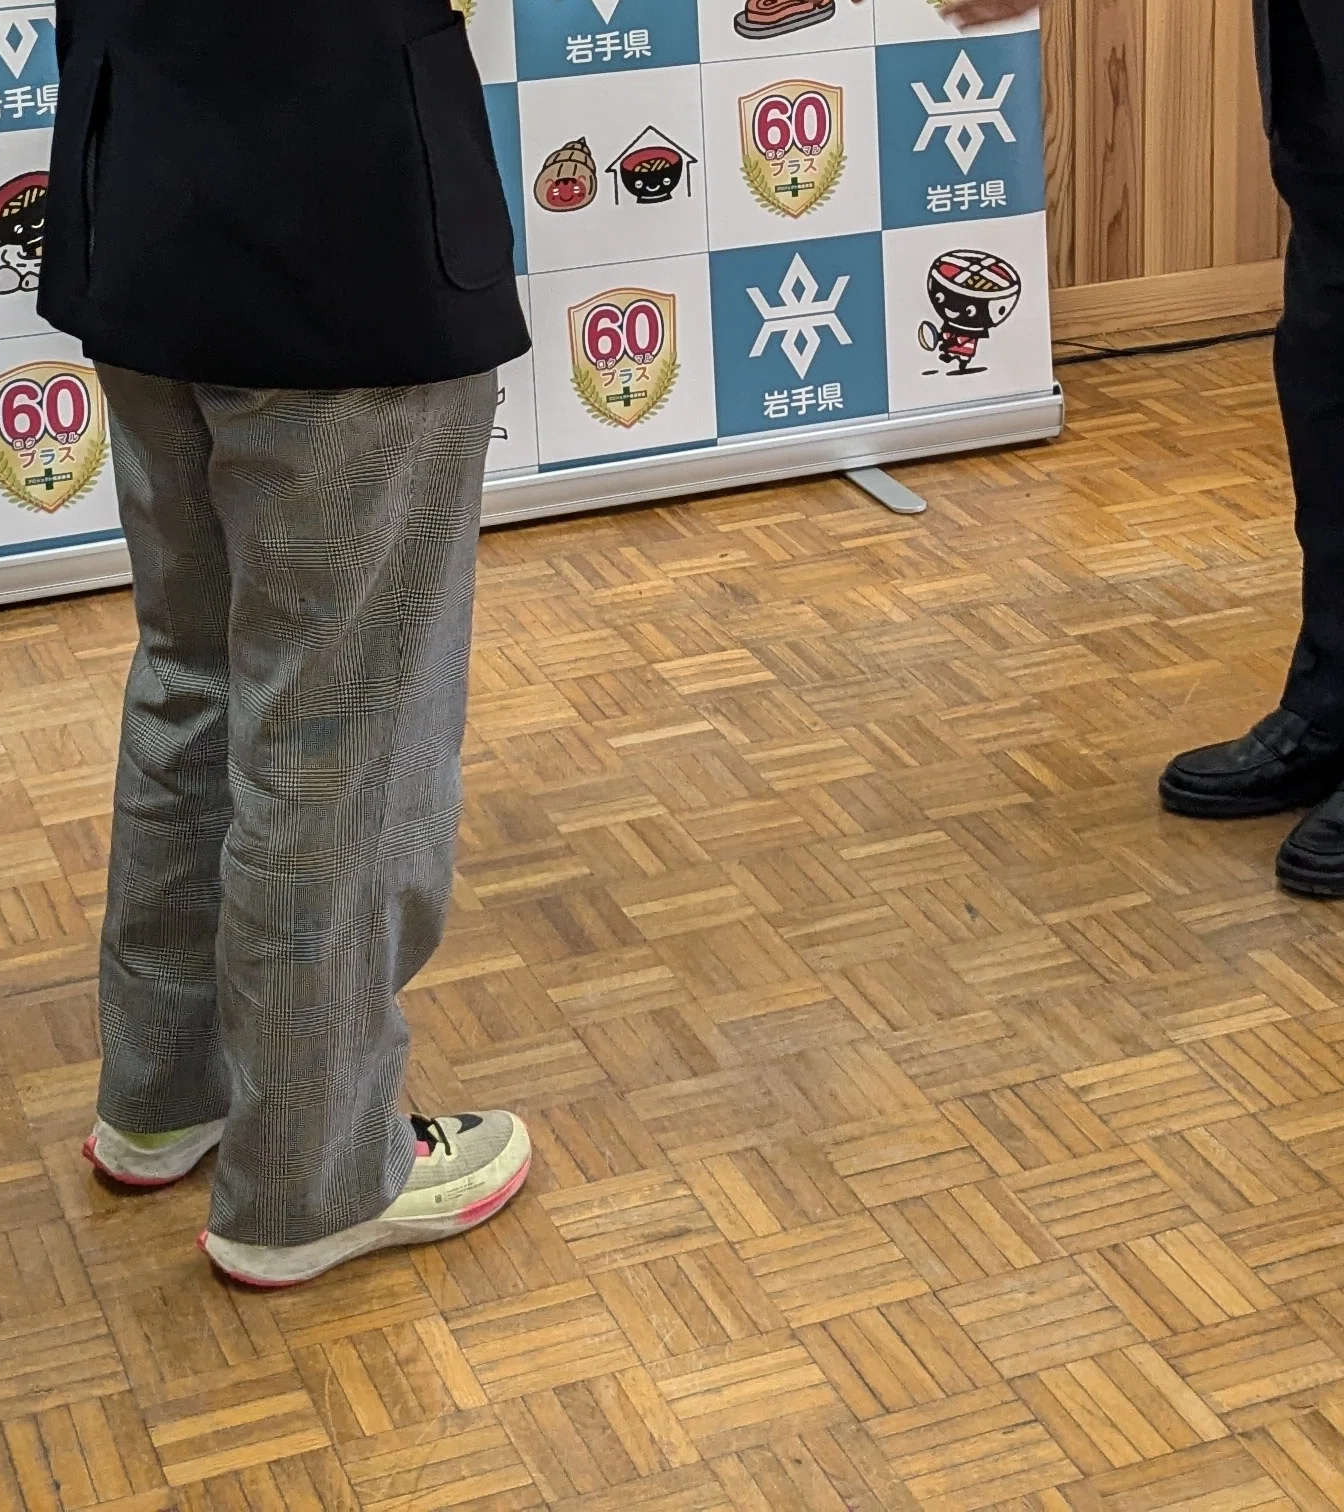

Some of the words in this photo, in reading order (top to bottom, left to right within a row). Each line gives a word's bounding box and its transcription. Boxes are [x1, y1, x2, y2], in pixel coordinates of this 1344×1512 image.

[566, 29, 652, 63] 岩手県
[754, 92, 830, 155] 60
[771, 158, 817, 176] プラス
[926, 180, 1006, 212] 岩手県
[584, 302, 662, 365] 60
[602, 369, 650, 386] プラス
[0, 376, 89, 445] 60
[763, 383, 844, 418] 岩手県
[18, 446, 75, 468] プラス
